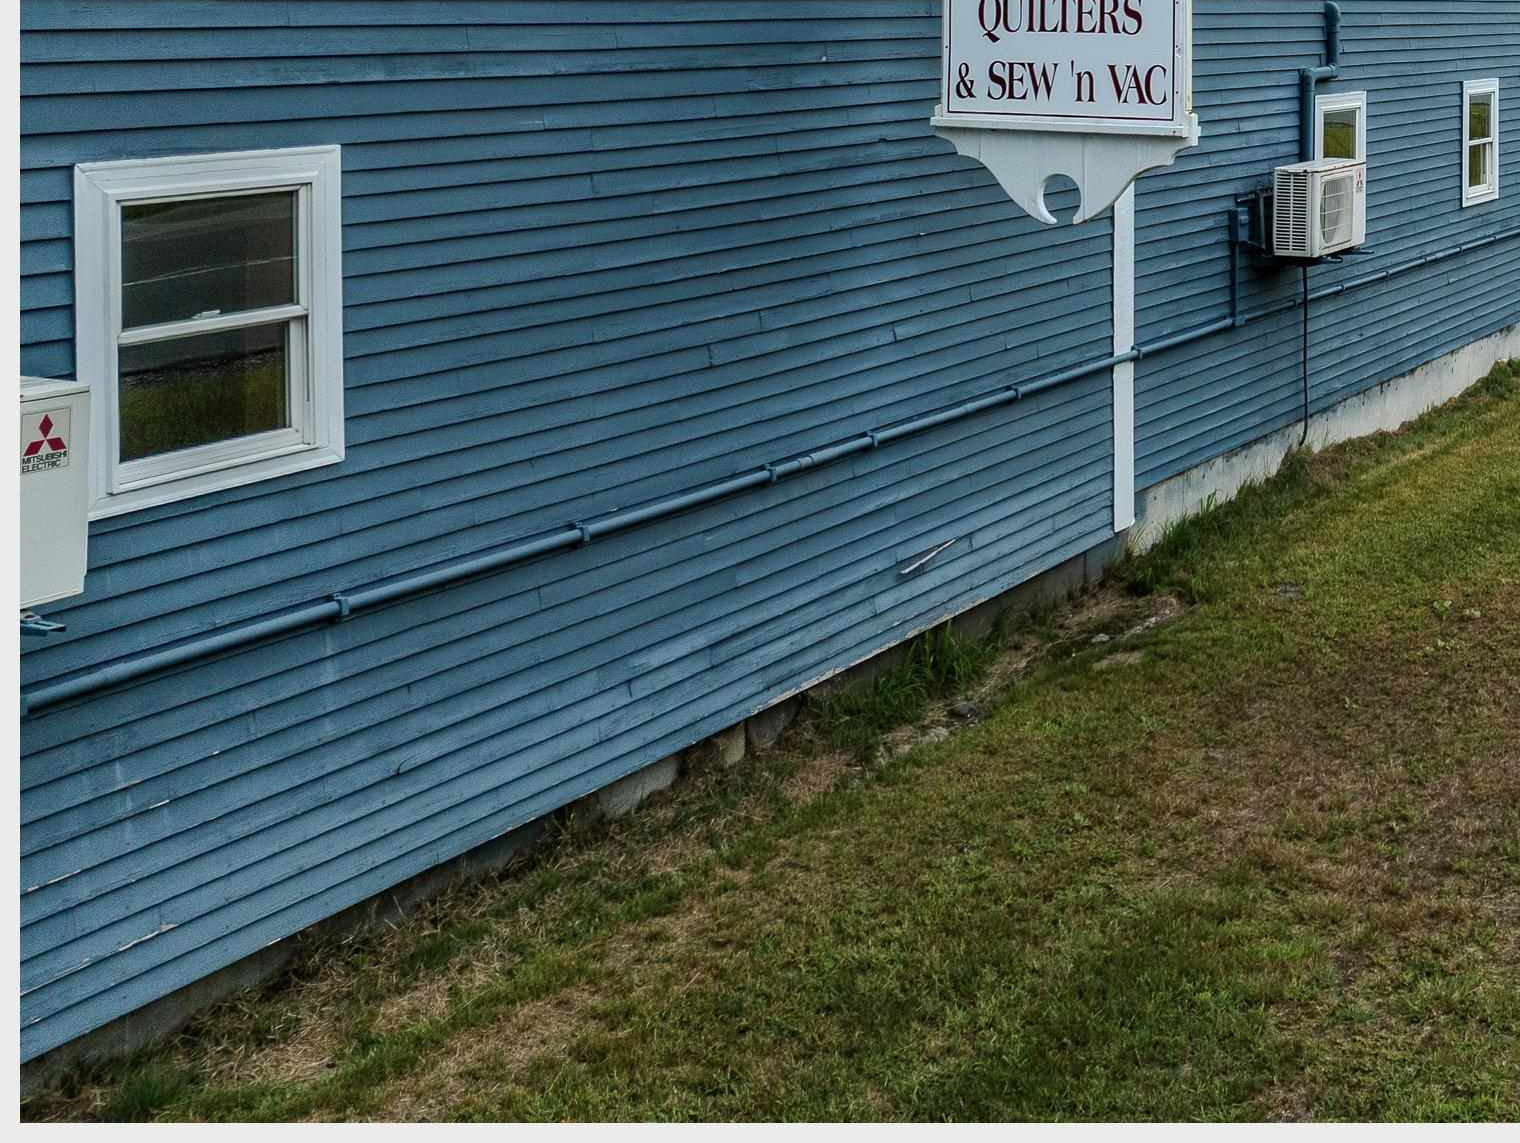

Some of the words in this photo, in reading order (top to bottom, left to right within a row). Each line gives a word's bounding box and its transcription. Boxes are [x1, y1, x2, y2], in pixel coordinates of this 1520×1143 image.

[955, 62, 977, 99] &
[987, 60, 1058, 101] SEW
[1070, 59, 1095, 103] 'n
[1107, 64, 1168, 106] VAC
[22, 458, 61, 472] ELECTRIC
